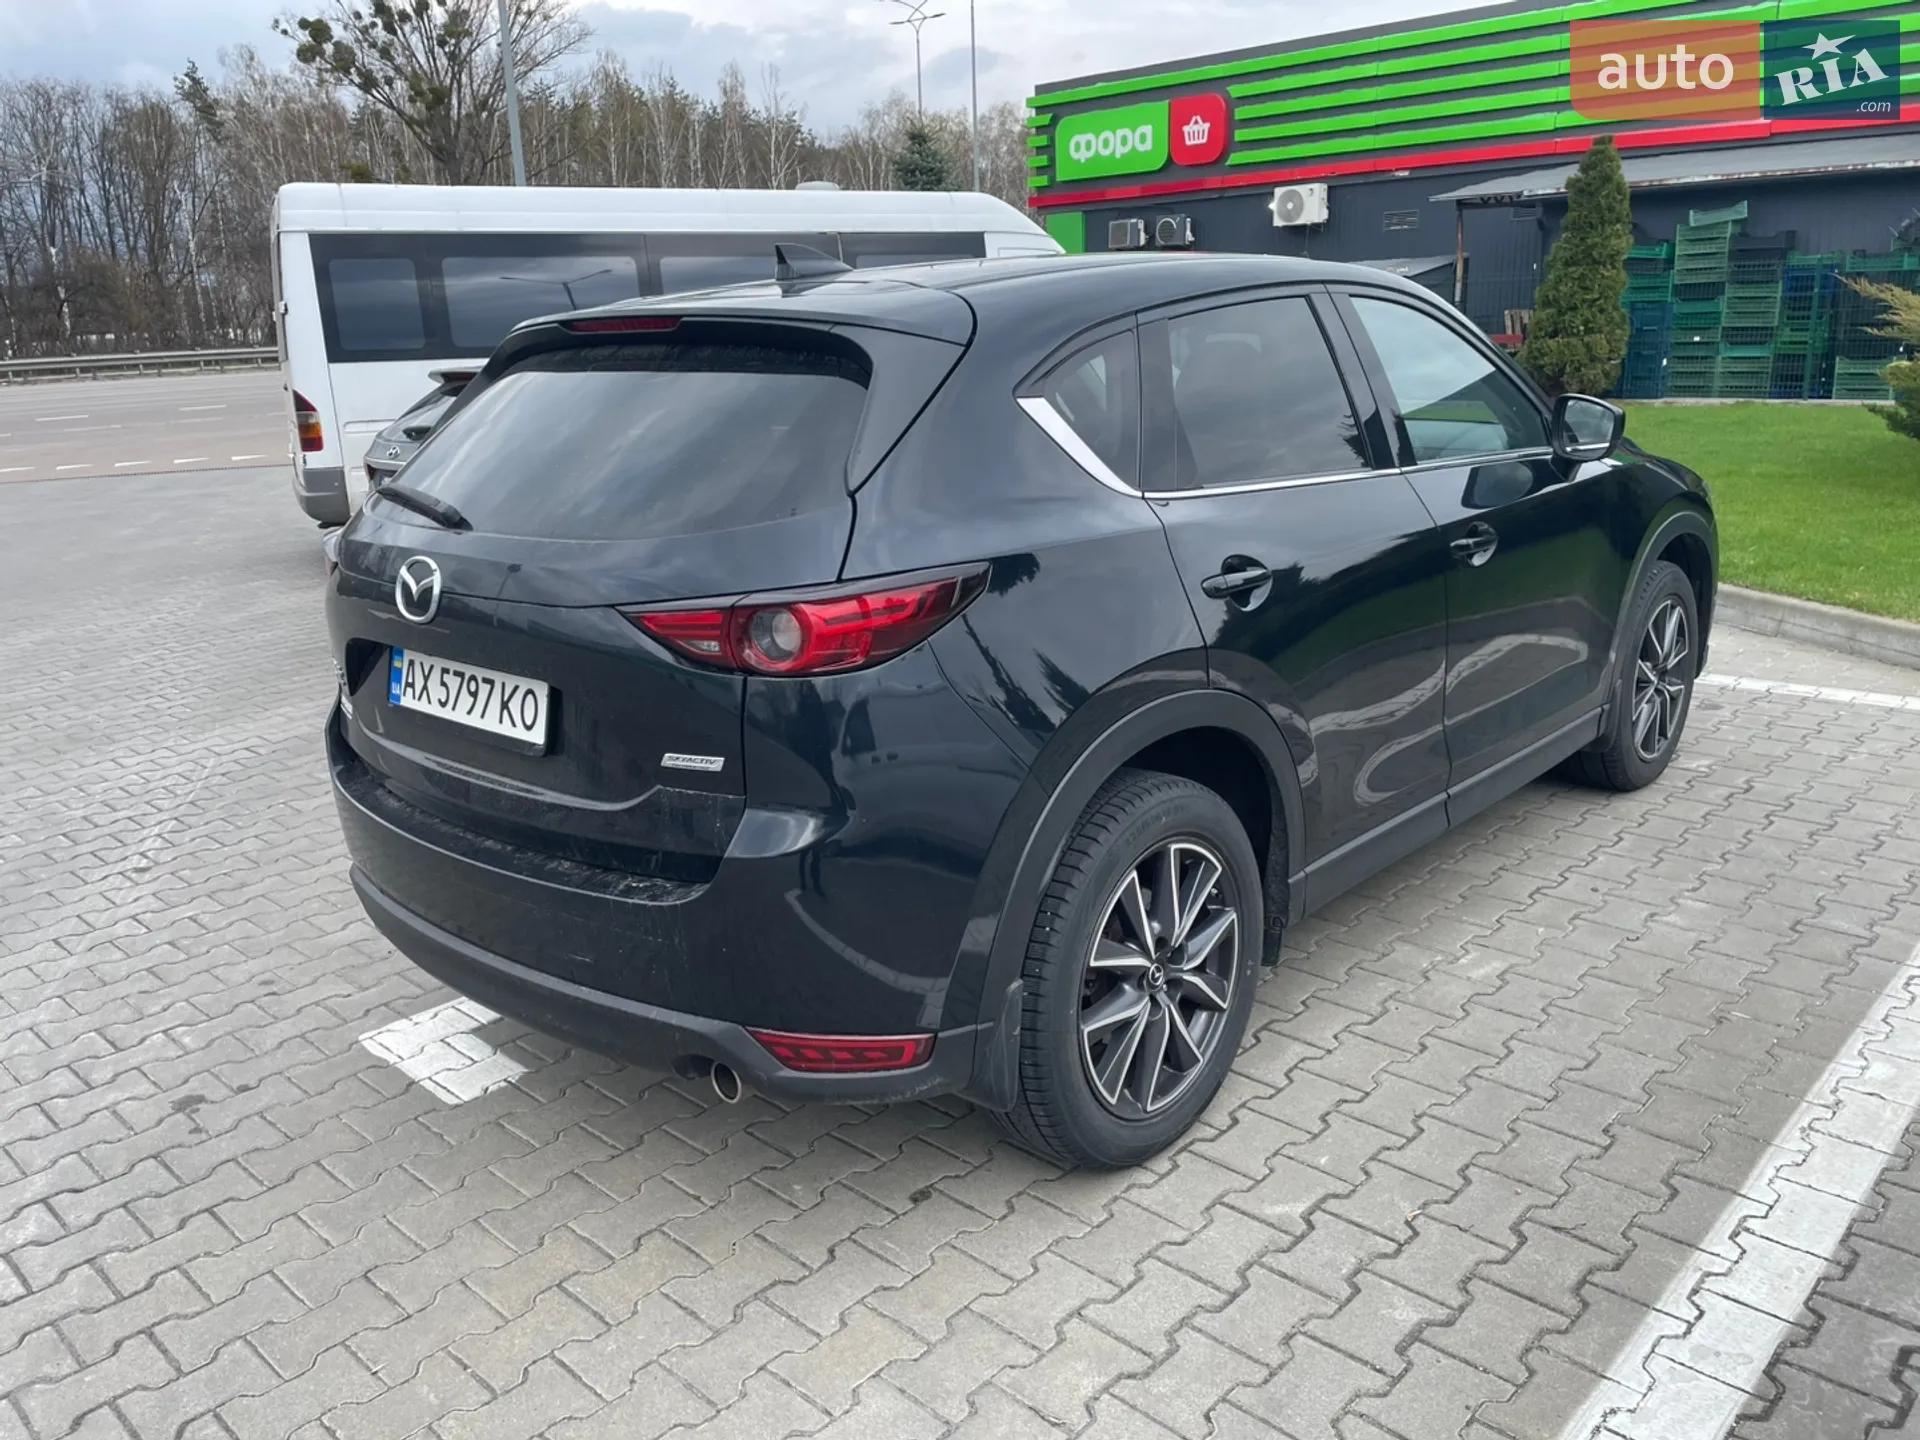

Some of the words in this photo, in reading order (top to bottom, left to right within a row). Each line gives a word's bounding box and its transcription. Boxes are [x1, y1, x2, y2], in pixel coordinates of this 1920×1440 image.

[1069, 124, 1153, 163] фора
[402, 658, 435, 705] AX
[437, 666, 496, 720] 5797
[499, 681, 539, 732] KO
